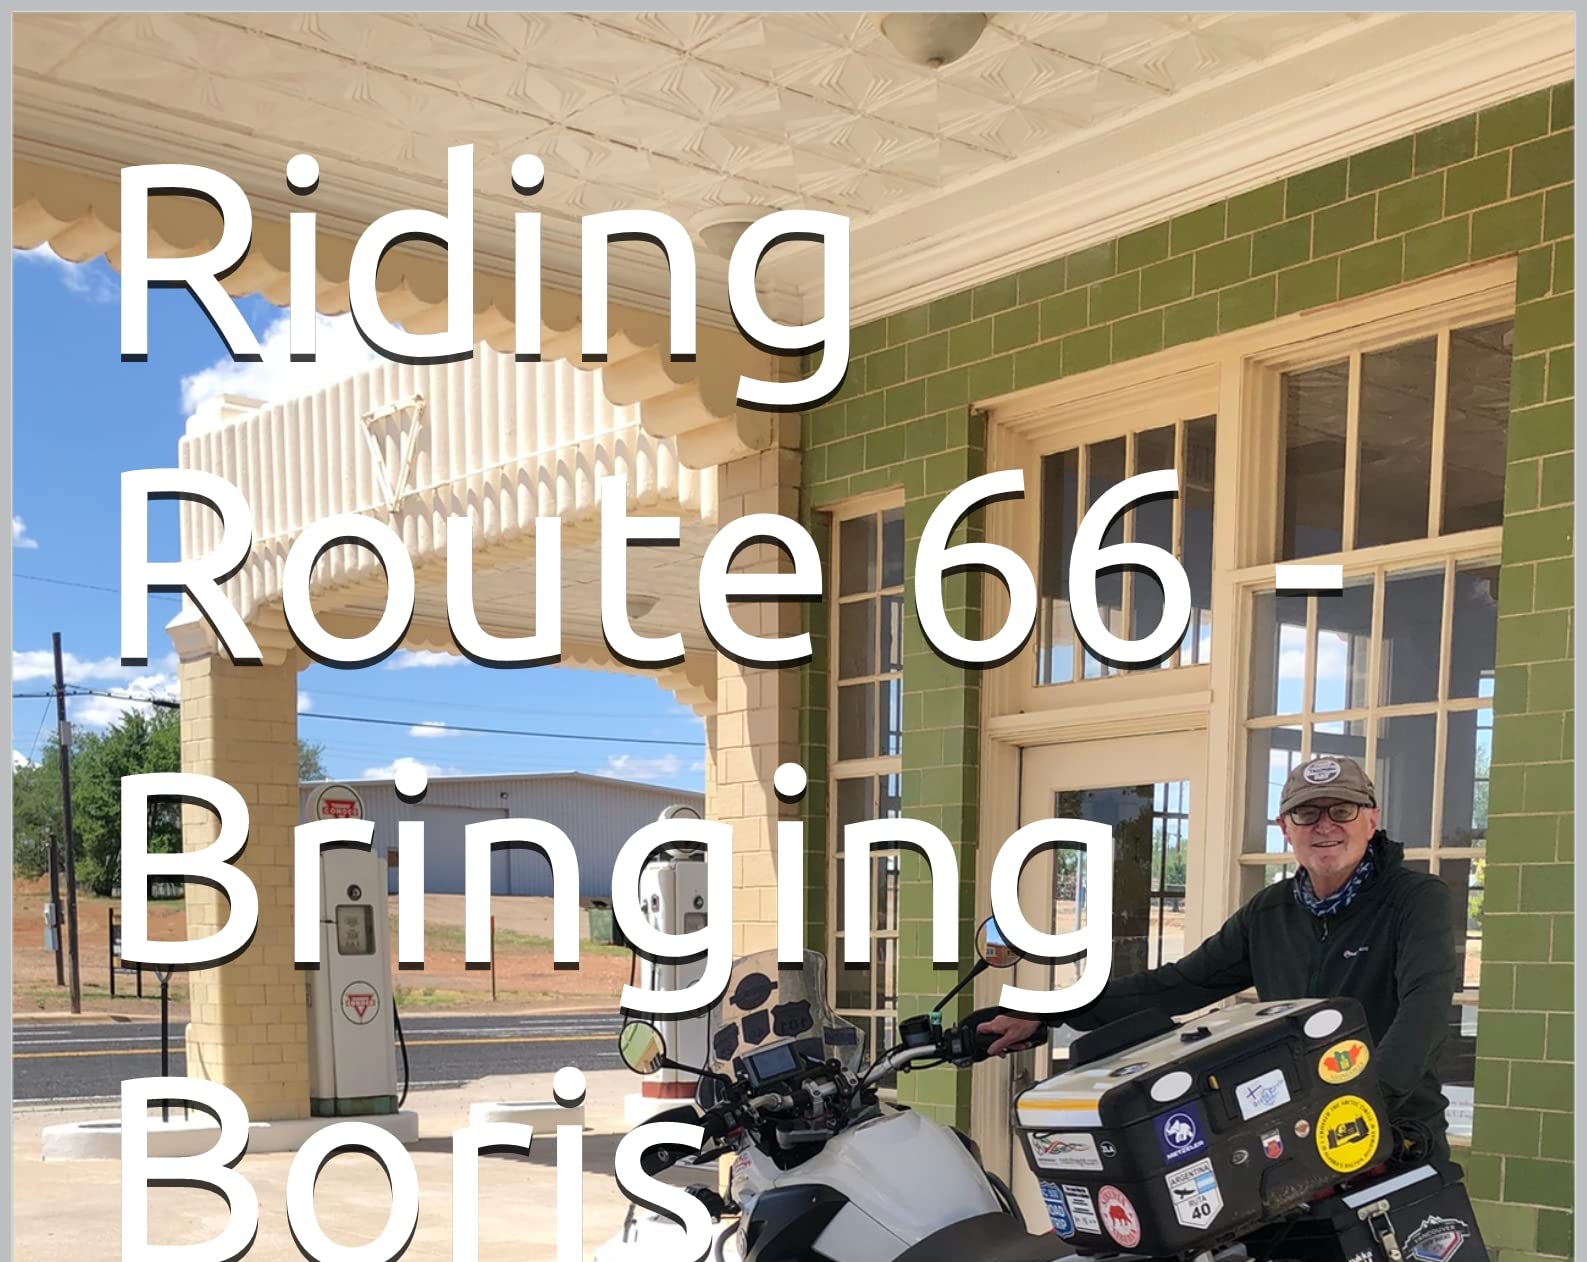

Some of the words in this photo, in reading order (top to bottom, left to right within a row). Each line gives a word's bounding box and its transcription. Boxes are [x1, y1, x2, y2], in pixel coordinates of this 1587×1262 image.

[1165, 1140, 1205, 1160] METZELER
[1169, 1164, 1211, 1186] ARGENTINA
[1191, 1202, 1212, 1220] 40
[1413, 1224, 1457, 1244] VANCOUVER
